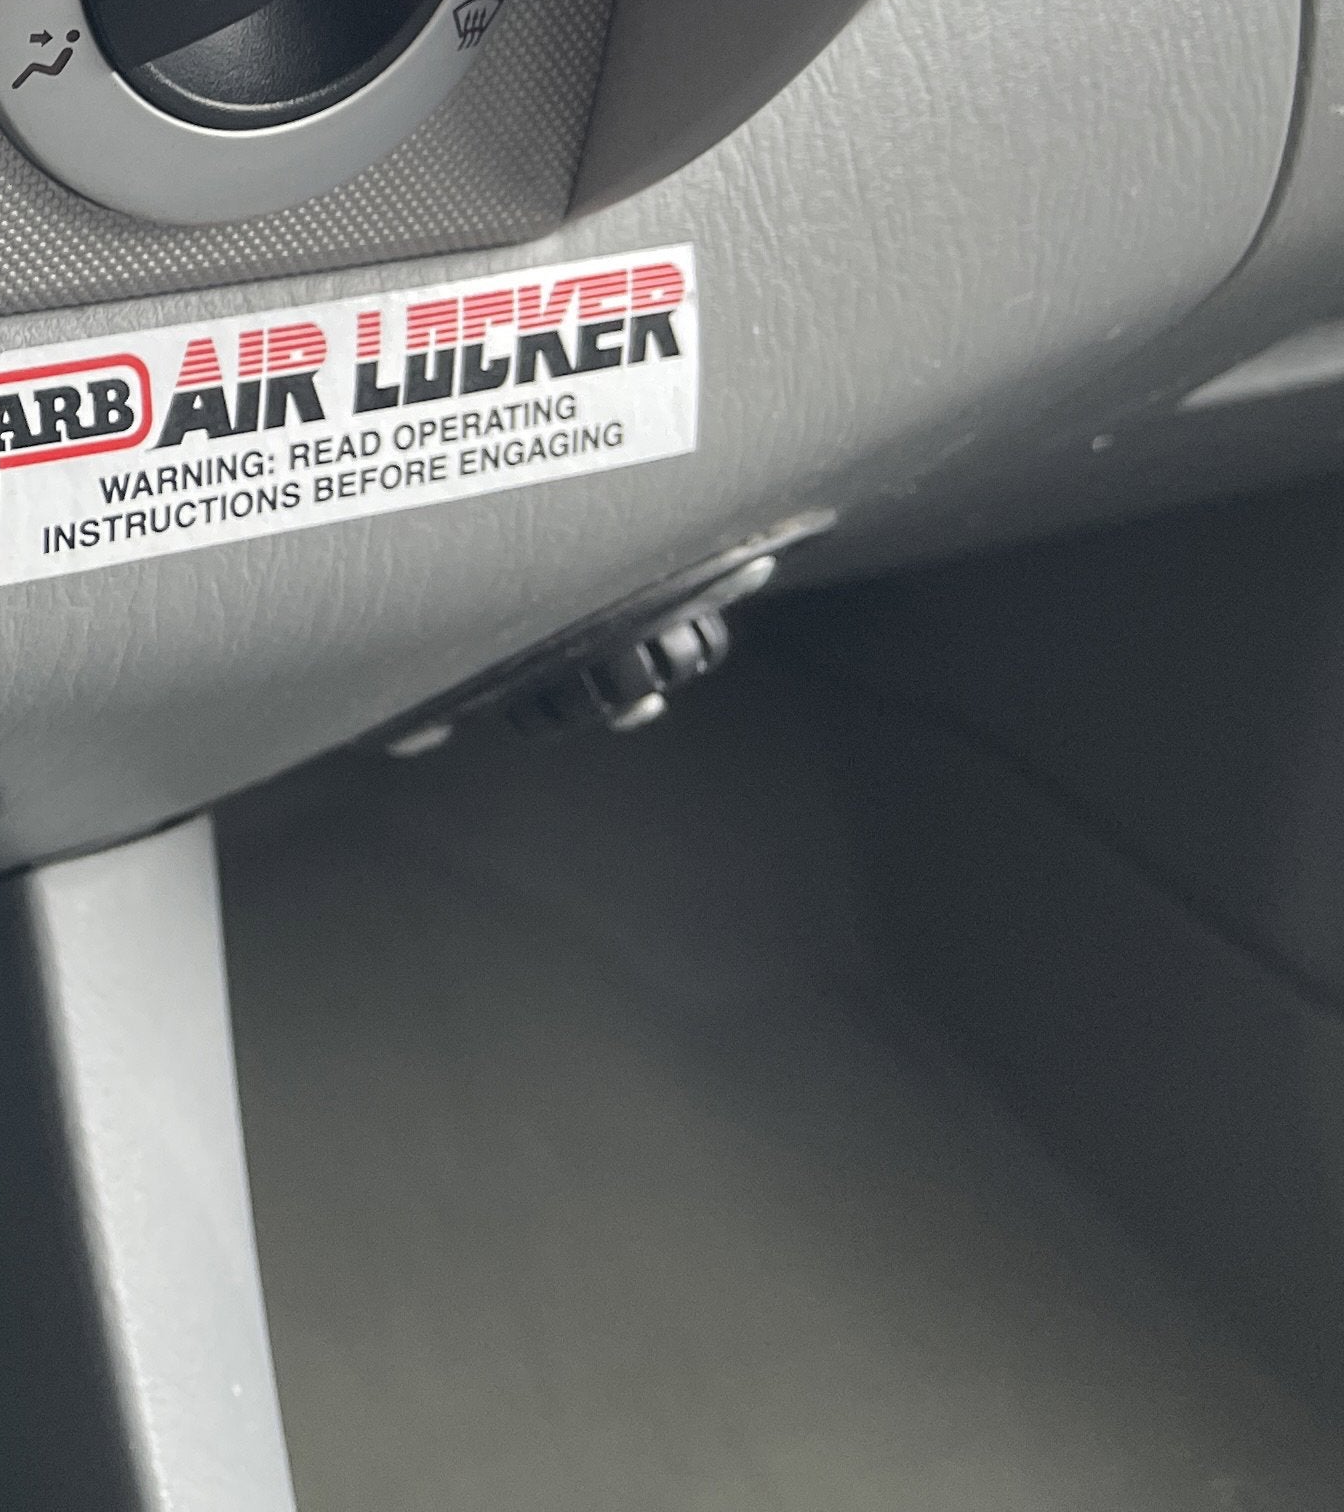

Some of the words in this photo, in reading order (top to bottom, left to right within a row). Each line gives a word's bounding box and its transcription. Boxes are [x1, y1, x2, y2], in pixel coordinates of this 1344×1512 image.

[148, 321, 328, 450] AIR
[353, 262, 685, 415] LOCKER
[42, 482, 301, 554] INSTRUCTIONS
[314, 454, 448, 503] BEFORE
[459, 421, 625, 476] ENGAGING
[99, 451, 275, 505] WARNING:
[289, 430, 381, 471] READ
[393, 392, 578, 450] OPERATING
